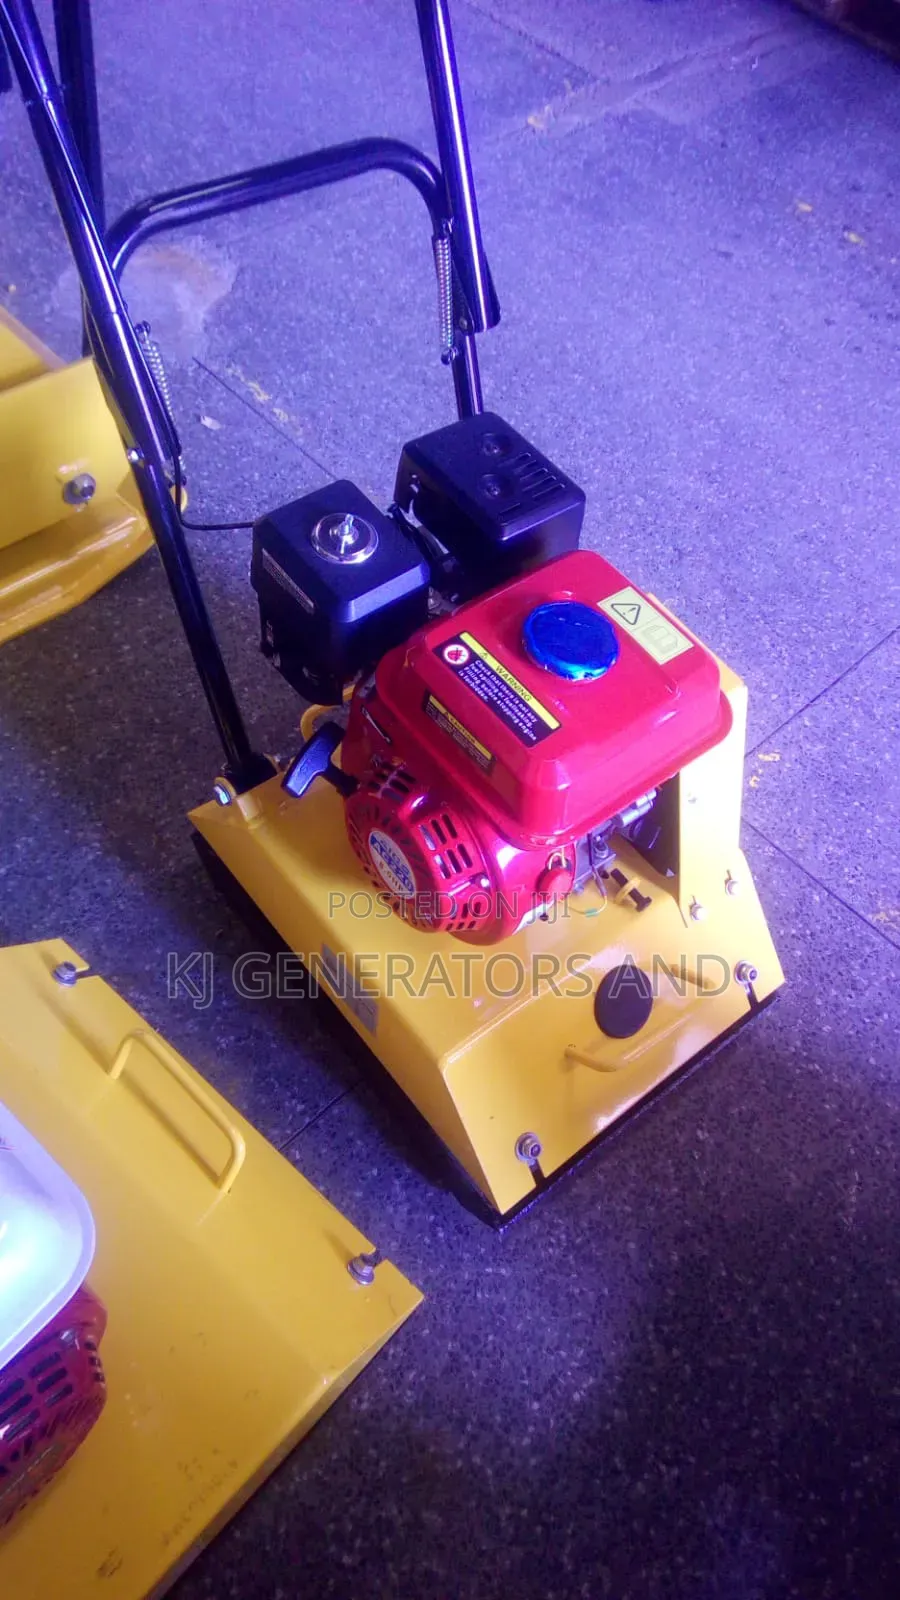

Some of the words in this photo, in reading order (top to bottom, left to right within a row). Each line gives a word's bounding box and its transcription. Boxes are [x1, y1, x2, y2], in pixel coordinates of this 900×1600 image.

[475, 660, 491, 675] Check
[489, 674, 502, 686] that
[499, 684, 515, 699] there
[517, 702, 529, 713] not
[525, 711, 538, 723] any
[477, 672, 500, 693] spilling
[495, 666, 532, 702] WARNING
[479, 683, 499, 701] before
[494, 699, 520, 723] stopping
[516, 721, 538, 741] engine
